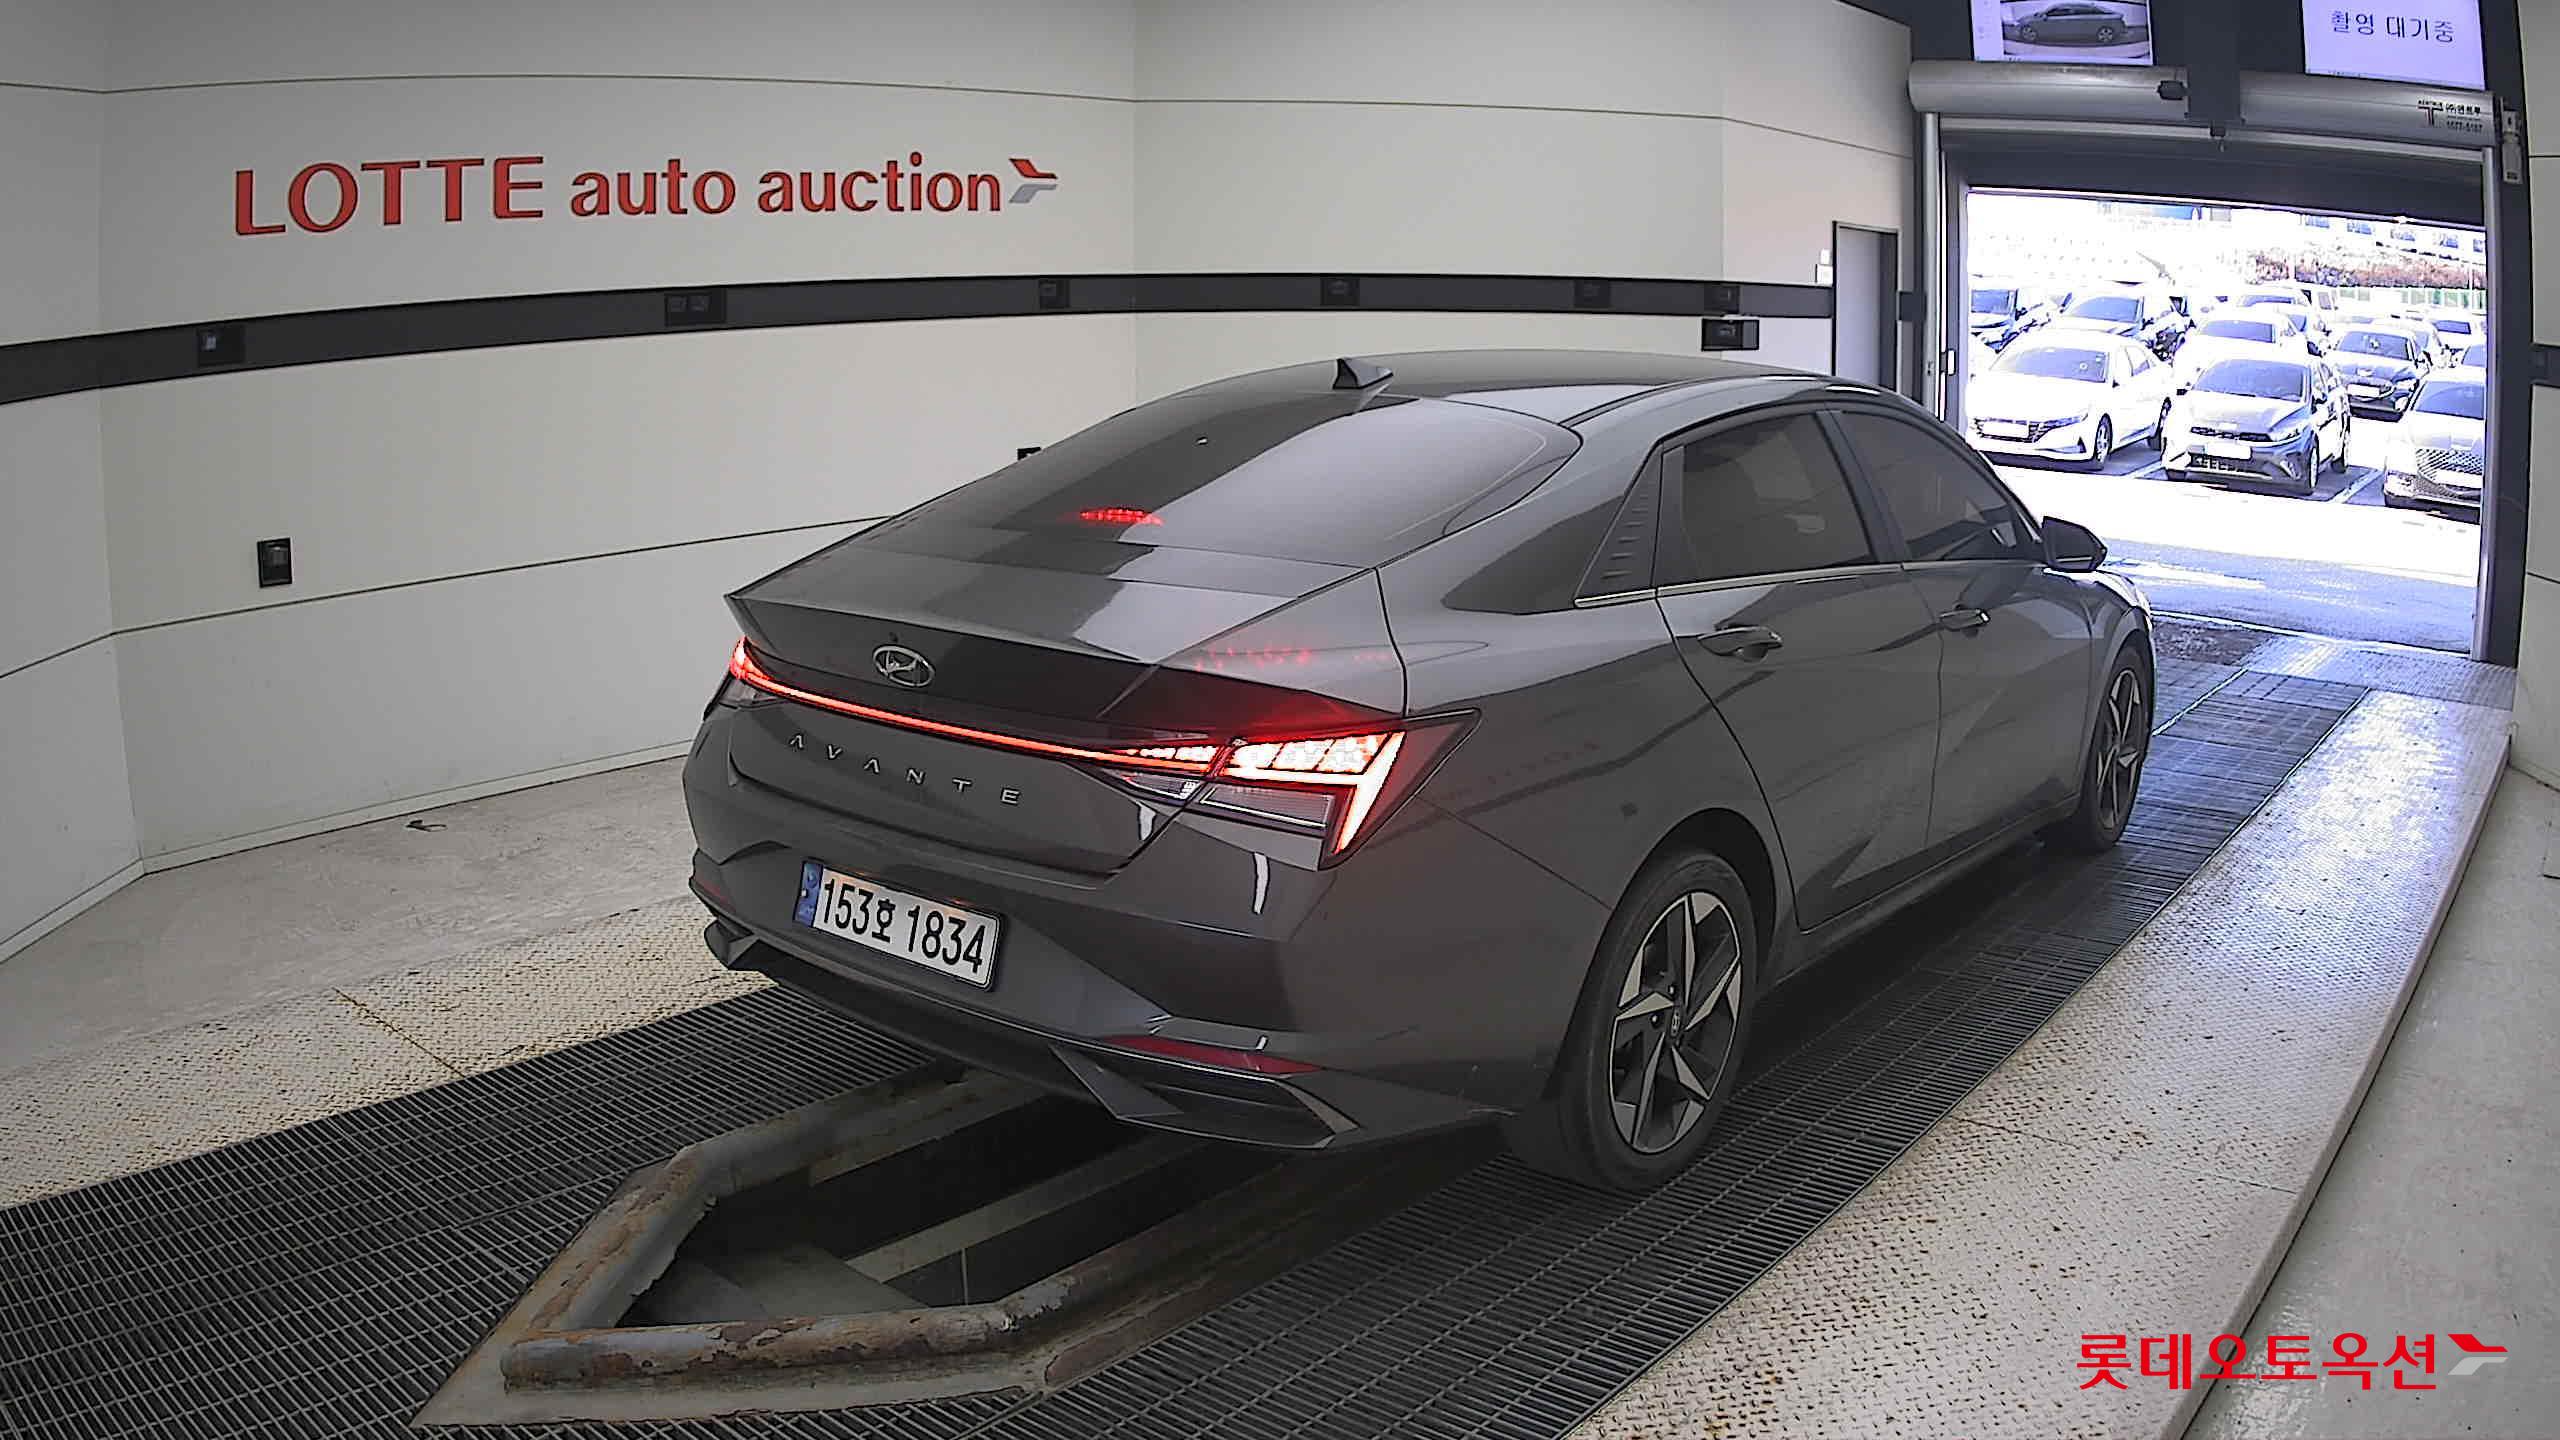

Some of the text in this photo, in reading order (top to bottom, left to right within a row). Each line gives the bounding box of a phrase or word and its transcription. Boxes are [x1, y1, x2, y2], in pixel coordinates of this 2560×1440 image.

[2331, 10, 2375, 36] 촬영
[235, 151, 1001, 236] LOTTE auto auction
[789, 733, 1021, 806] AVANTE
[822, 877, 986, 974] 153호 1834
